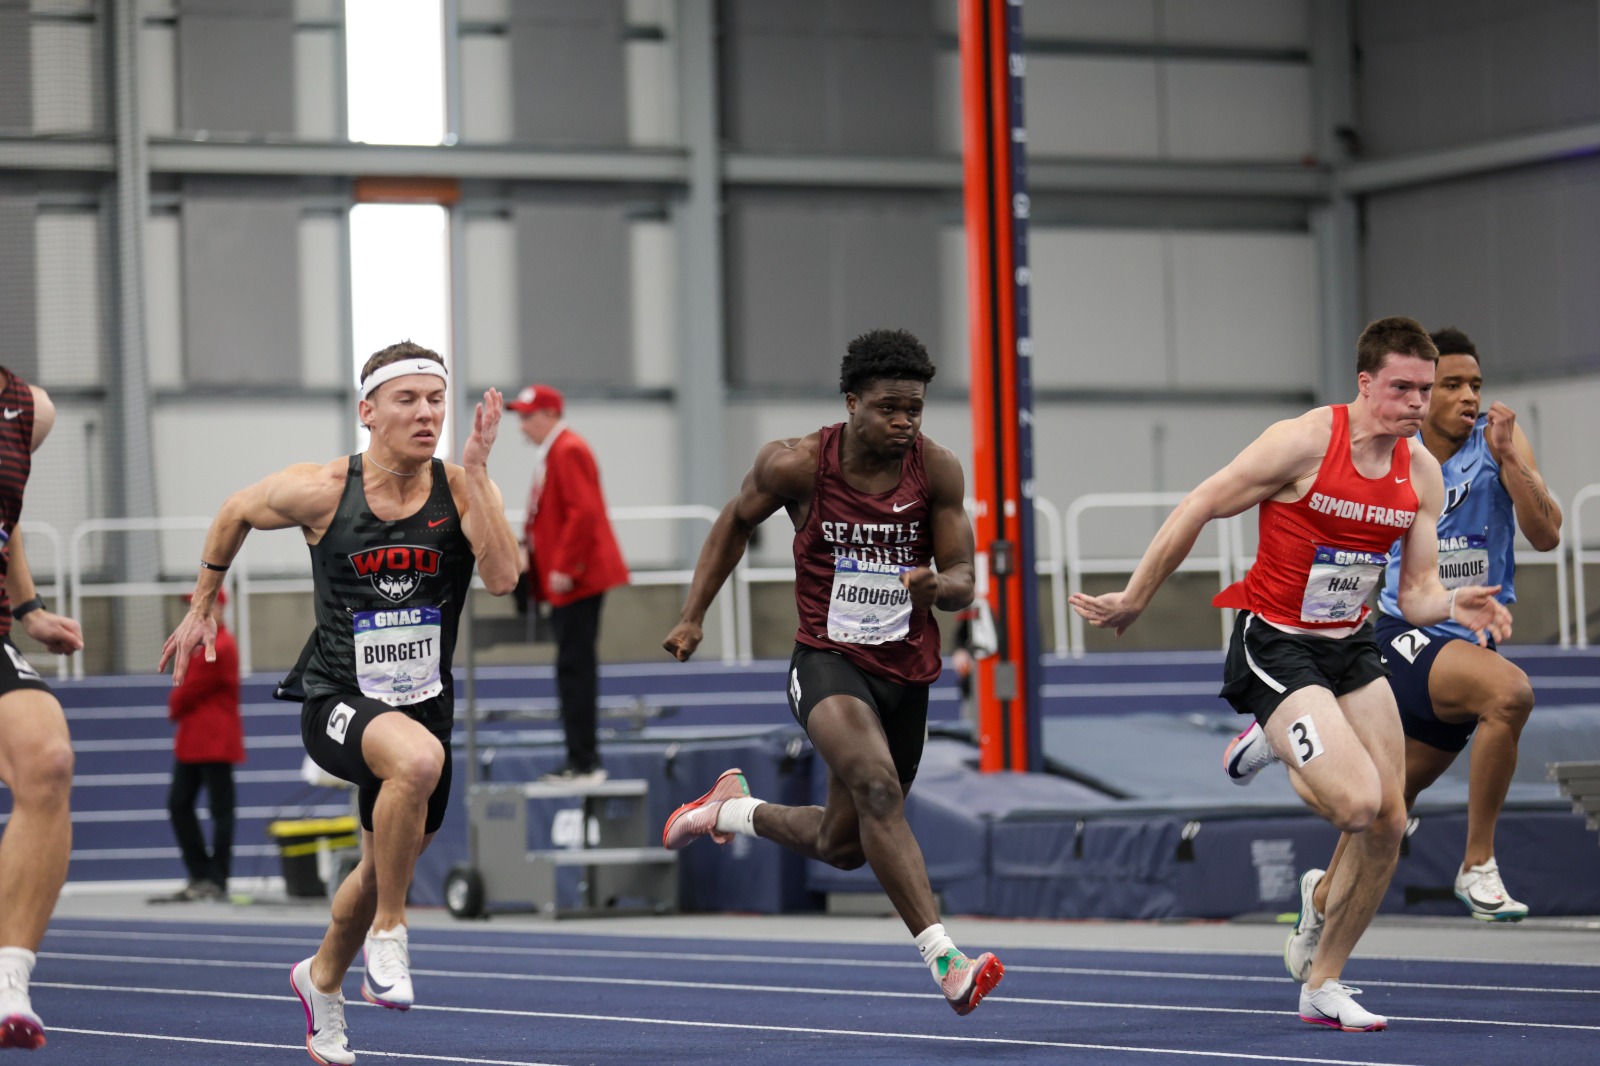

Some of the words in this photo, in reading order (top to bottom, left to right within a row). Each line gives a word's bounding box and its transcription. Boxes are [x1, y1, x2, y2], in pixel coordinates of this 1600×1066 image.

[1309, 492, 1364, 521] SIMON
[822, 521, 919, 544] SEATTLE
[353, 547, 439, 575] WOU
[836, 583, 909, 606] ABOUDOU
[1327, 577, 1360, 591] HALL
[374, 609, 421, 627] GNAC
[364, 638, 432, 664] BURGETT
[1398, 633, 1425, 657] 2
[329, 708, 348, 735] 5
[1292, 722, 1314, 762] 3
